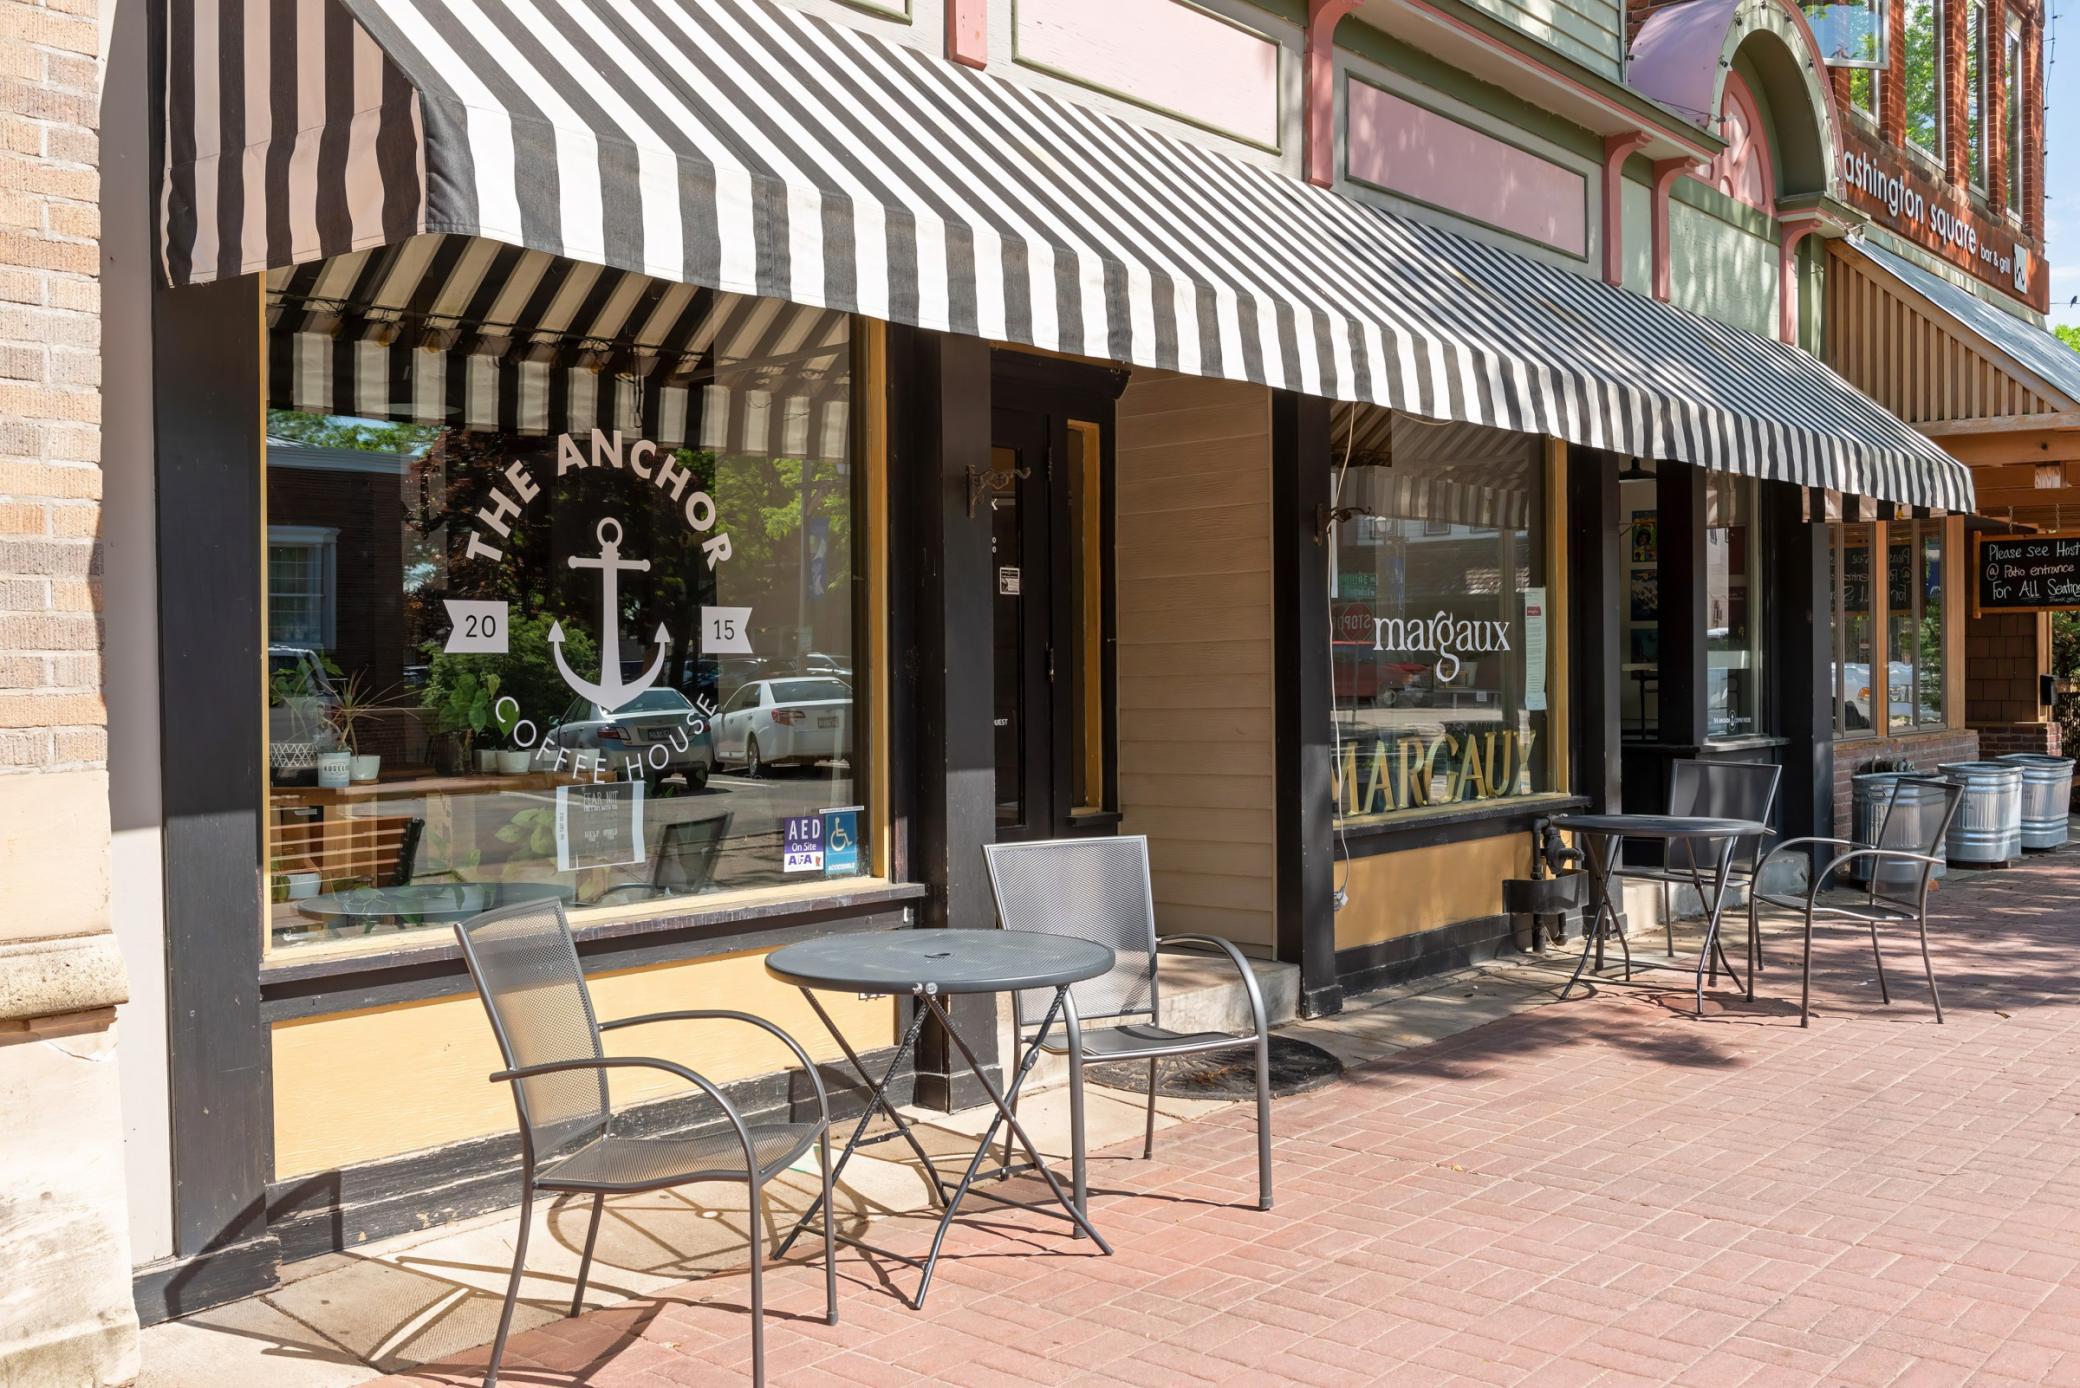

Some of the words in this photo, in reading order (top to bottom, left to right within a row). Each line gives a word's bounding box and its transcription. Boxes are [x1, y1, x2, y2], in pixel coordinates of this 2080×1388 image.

[1844, 151, 1924, 224] ashington
[1930, 203, 1977, 255] square
[1980, 242, 1993, 263] bar
[1993, 250, 1999, 268] &
[466, 460, 540, 562] THE
[557, 428, 733, 571] ANCHOR
[1989, 544, 2022, 561] Please
[2026, 545, 2050, 558] see
[1986, 562, 2000, 581] @
[2004, 564, 2026, 579] Patio
[2030, 563, 2075, 577] entrance
[1992, 580, 2012, 600] For
[464, 615, 497, 638] 20
[713, 619, 735, 641] 15
[1372, 610, 1511, 682] margaux
[625, 692, 718, 783] HOUSE
[1331, 729, 1537, 816] MARGAUX
[789, 818, 821, 841] AED
[791, 842, 803, 852] On
[803, 842, 817, 851] Site
